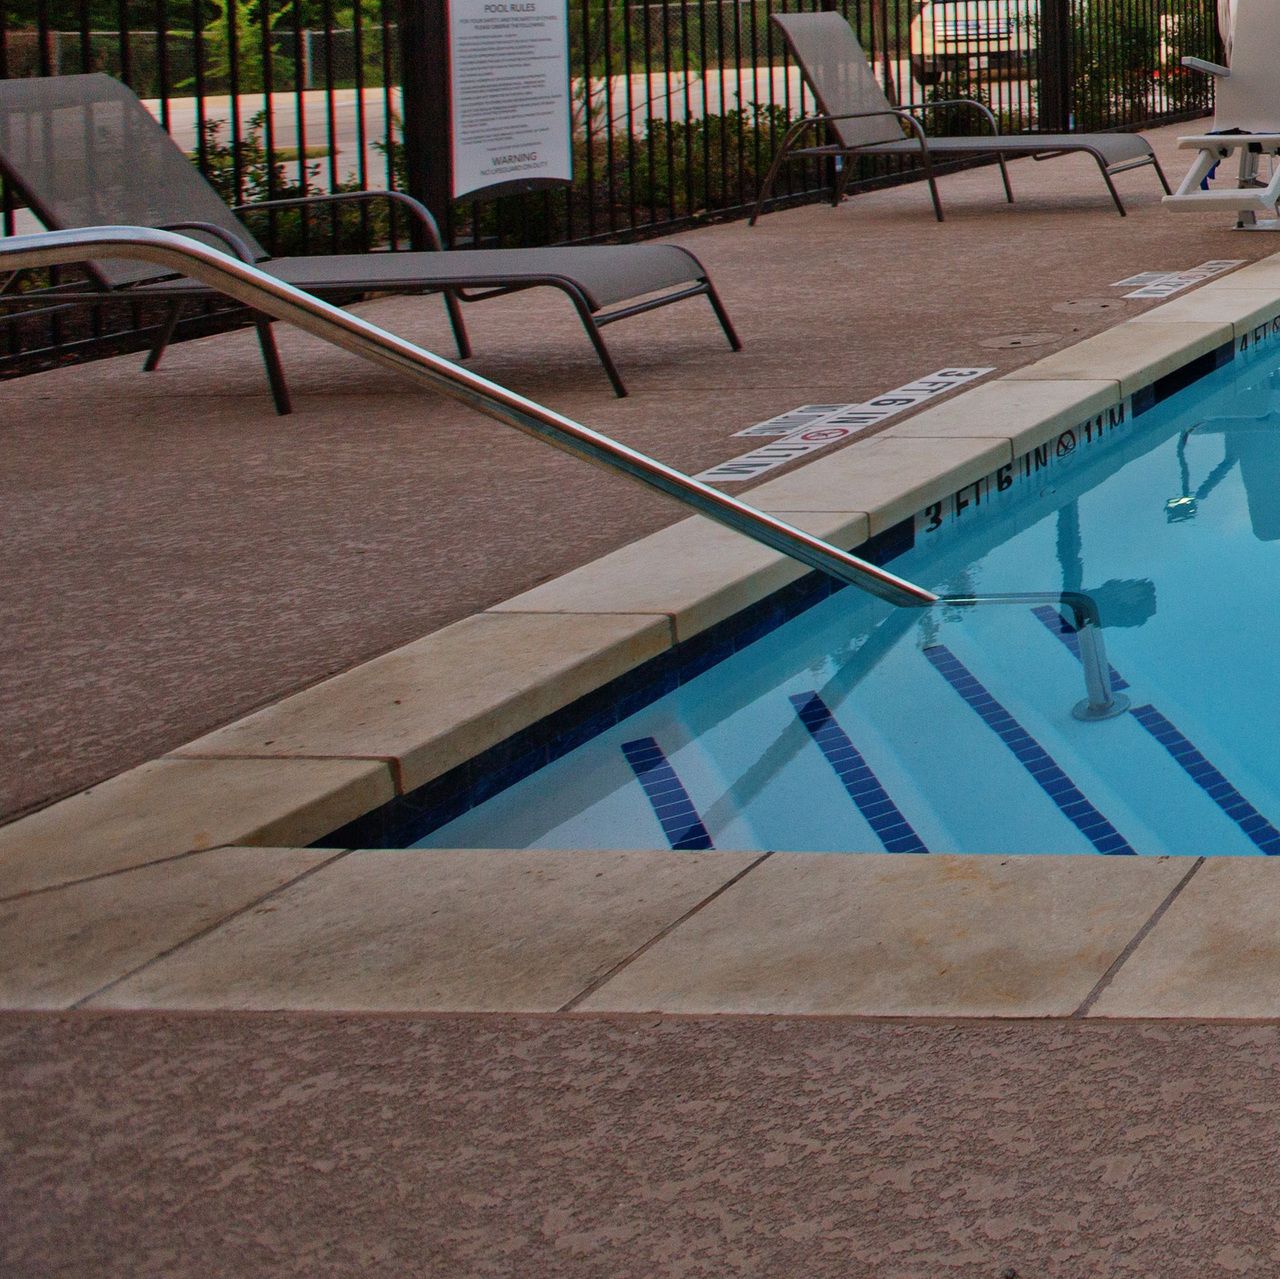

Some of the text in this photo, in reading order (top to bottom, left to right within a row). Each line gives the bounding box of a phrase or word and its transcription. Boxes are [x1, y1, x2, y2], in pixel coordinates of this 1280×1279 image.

[484, 3, 536, 13] POOL RULES
[491, 151, 537, 166] WARNING
[925, 502, 943, 533] 3
[956, 477, 986, 517] FT
[1025, 443, 1049, 477] IN
[1108, 403, 1125, 431] M
